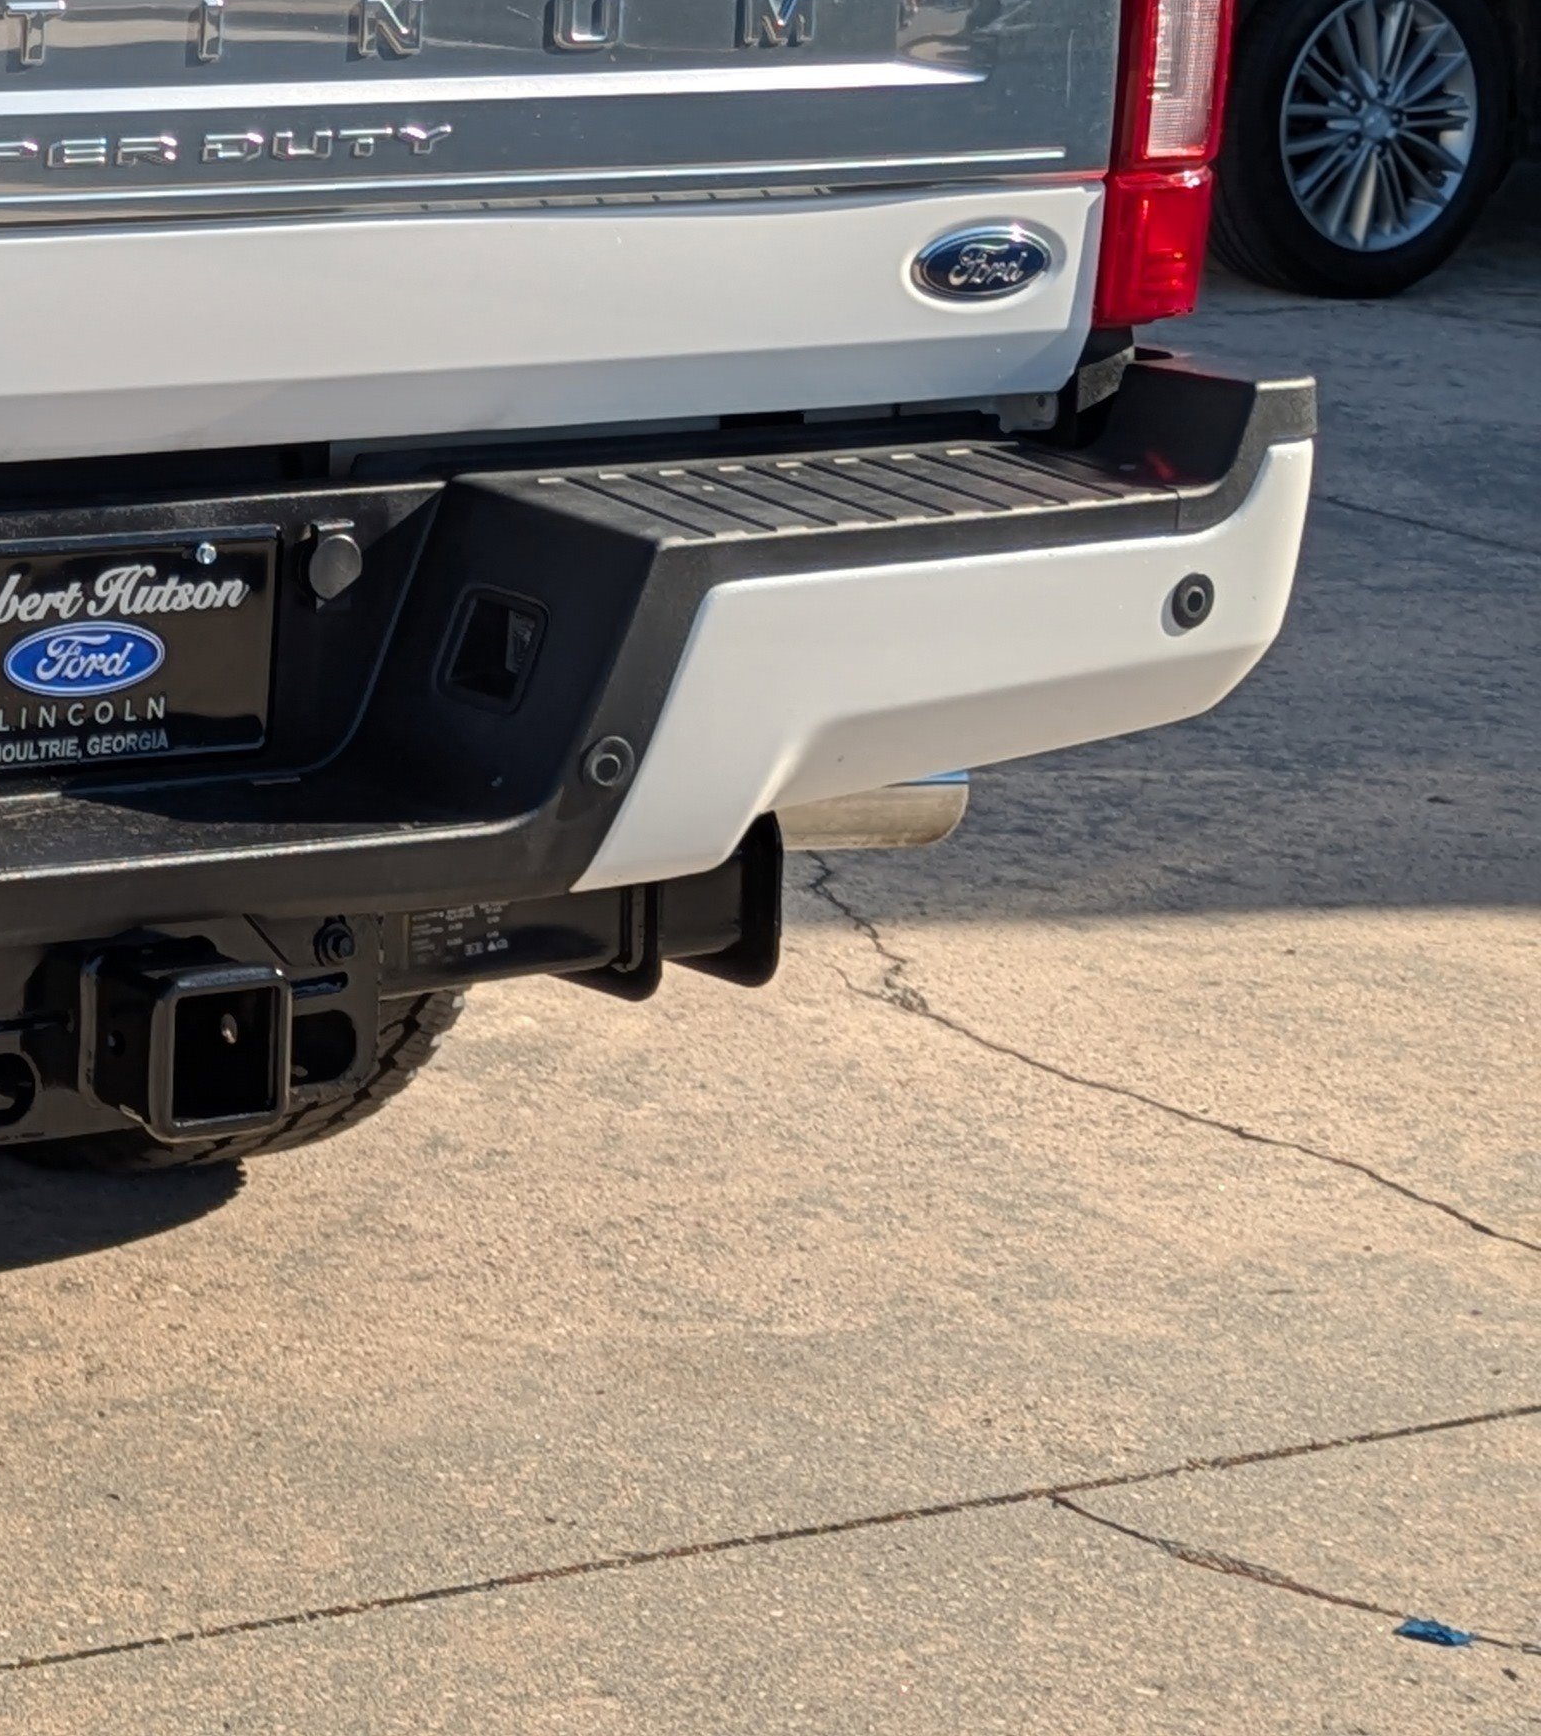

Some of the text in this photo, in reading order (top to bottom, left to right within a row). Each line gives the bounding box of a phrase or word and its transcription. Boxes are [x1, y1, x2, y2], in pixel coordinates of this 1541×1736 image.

[201, 124, 453, 164] DUTY
[948, 242, 1029, 286] Ford
[85, 563, 250, 621] Hutson
[34, 633, 136, 682] Ford
[86, 728, 169, 754] GEORGIA
